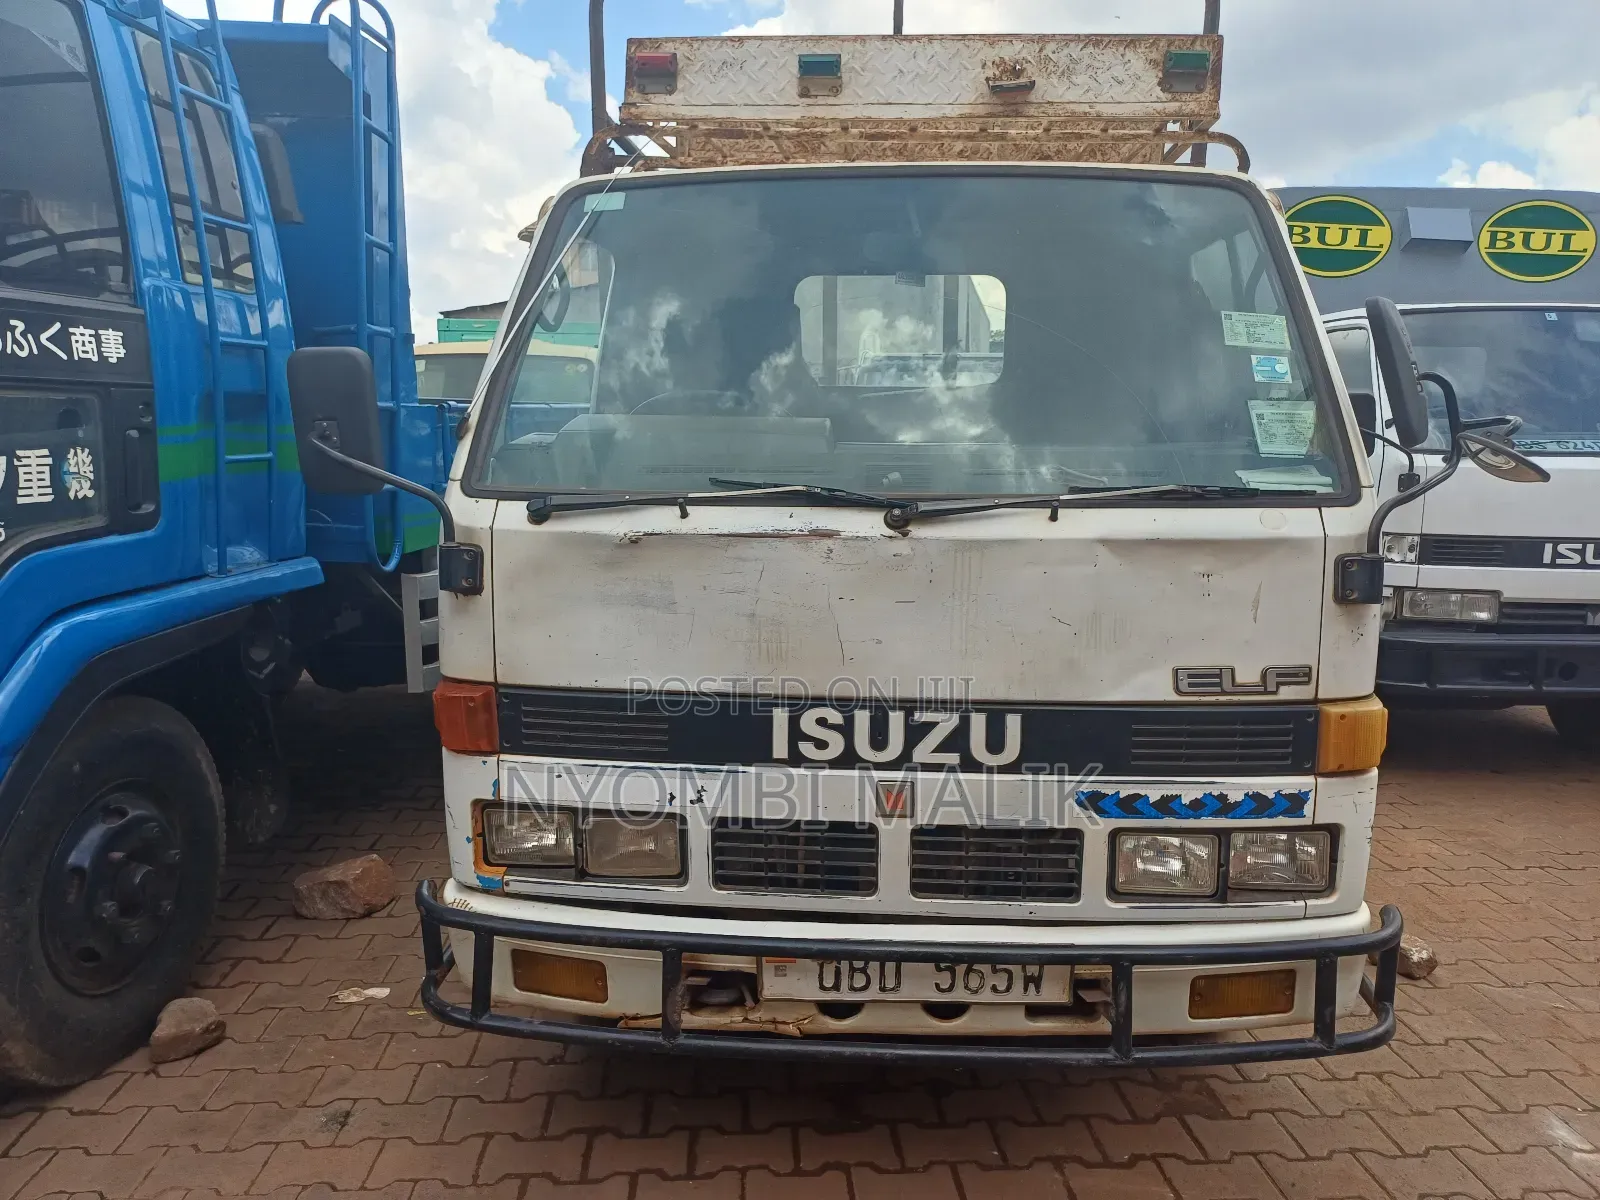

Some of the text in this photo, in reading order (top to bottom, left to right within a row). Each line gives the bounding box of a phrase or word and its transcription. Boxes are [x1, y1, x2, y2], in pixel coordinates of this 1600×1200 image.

[1288, 224, 1384, 249] BUL
[1484, 230, 1588, 254] BUL
[0, 319, 127, 364] ふく商事
[1173, 665, 1312, 696] ELF
[772, 707, 1023, 766] ISUZU
[934, 962, 1044, 994] 565W
